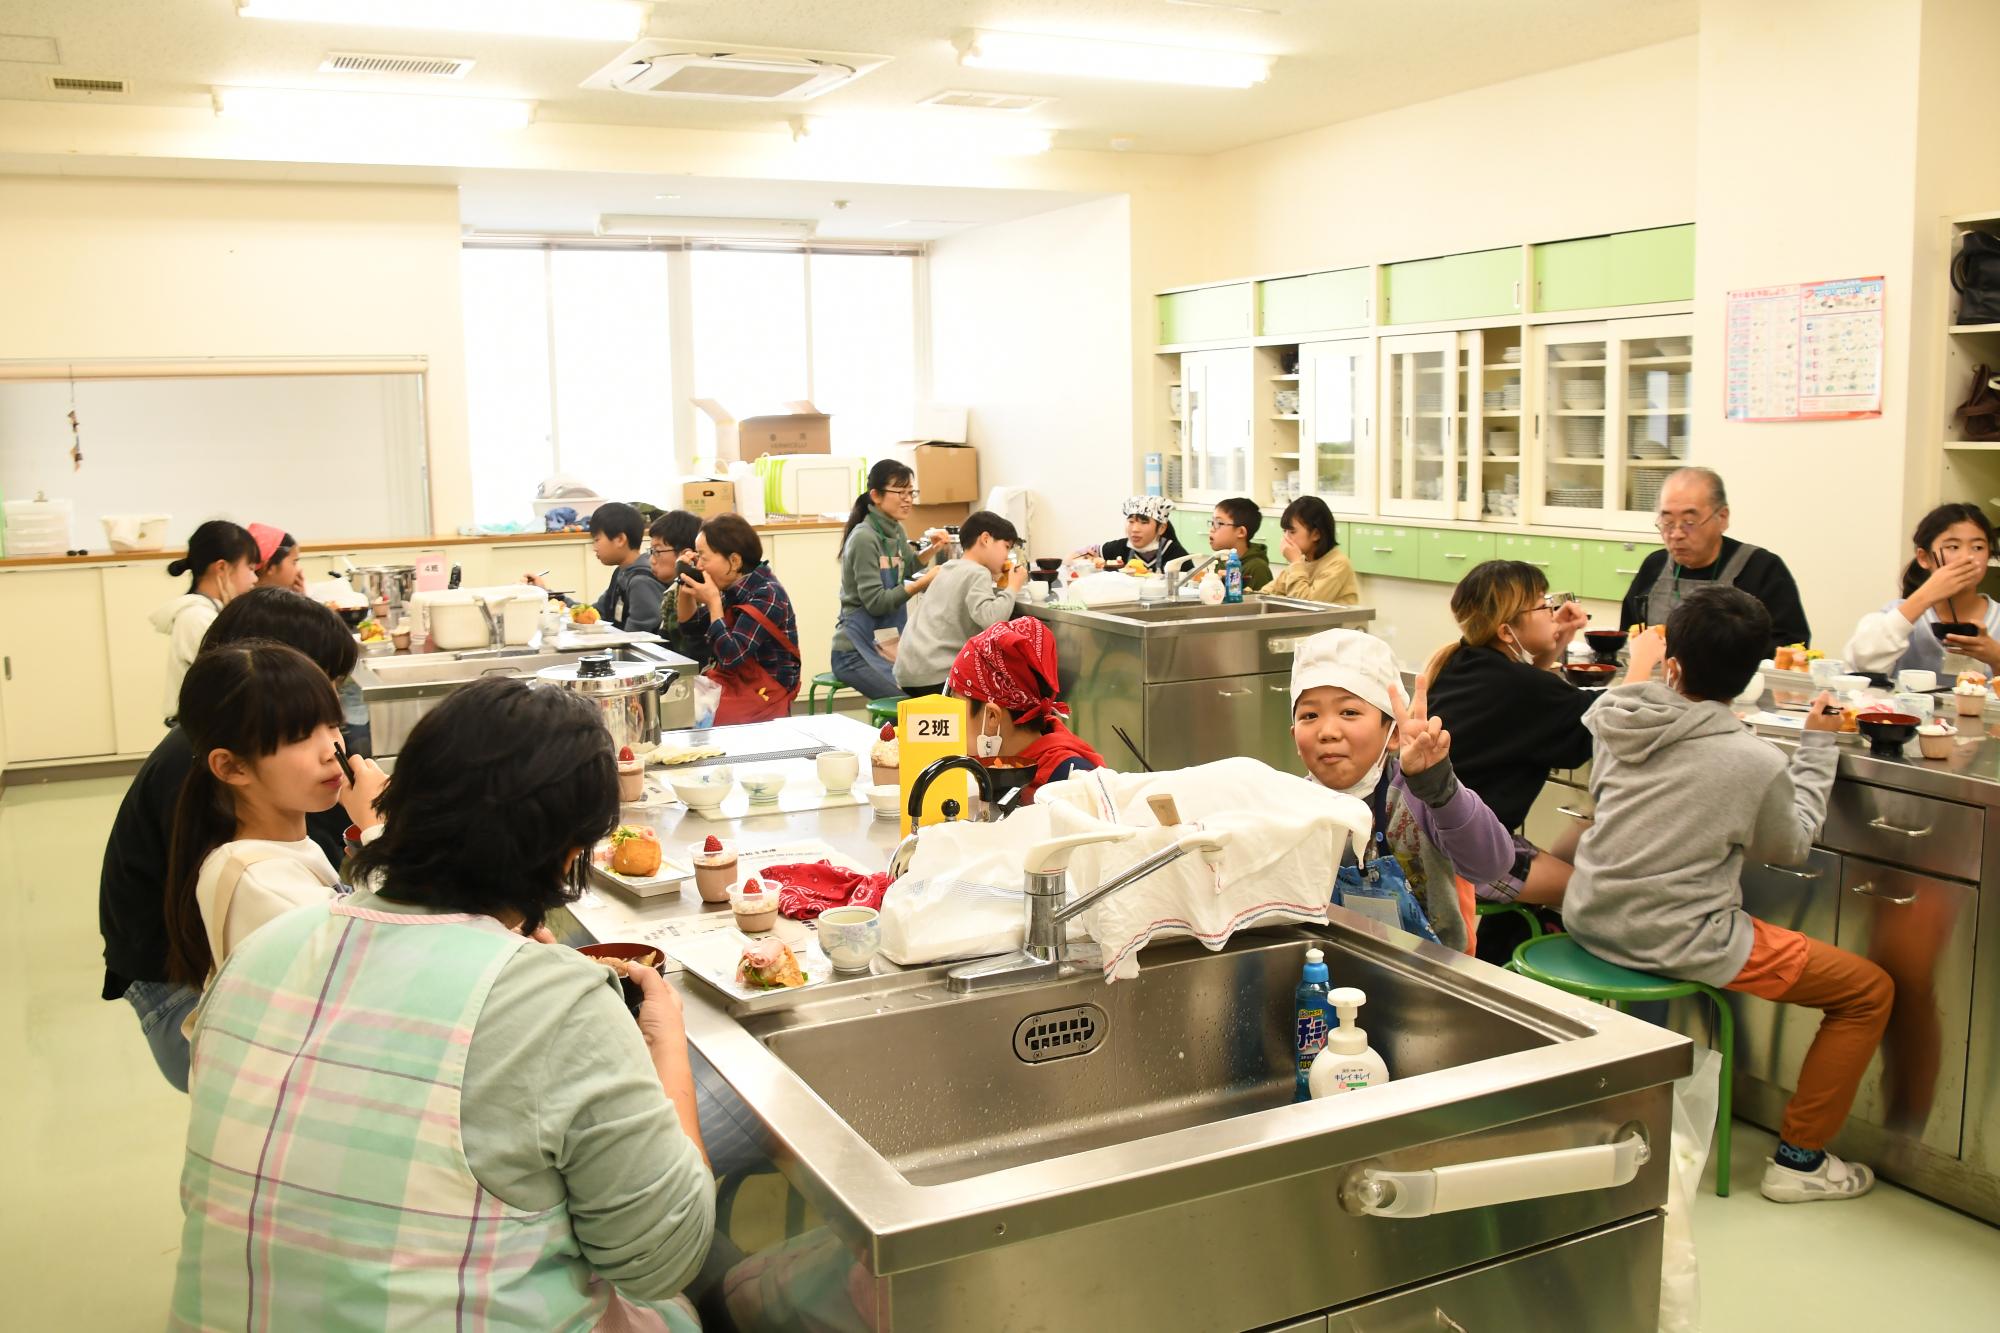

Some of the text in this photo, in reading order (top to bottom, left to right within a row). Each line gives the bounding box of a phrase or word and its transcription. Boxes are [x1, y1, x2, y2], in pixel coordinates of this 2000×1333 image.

[918, 719, 950, 737] 2班
[1298, 1017, 1327, 1049] チャーミー
